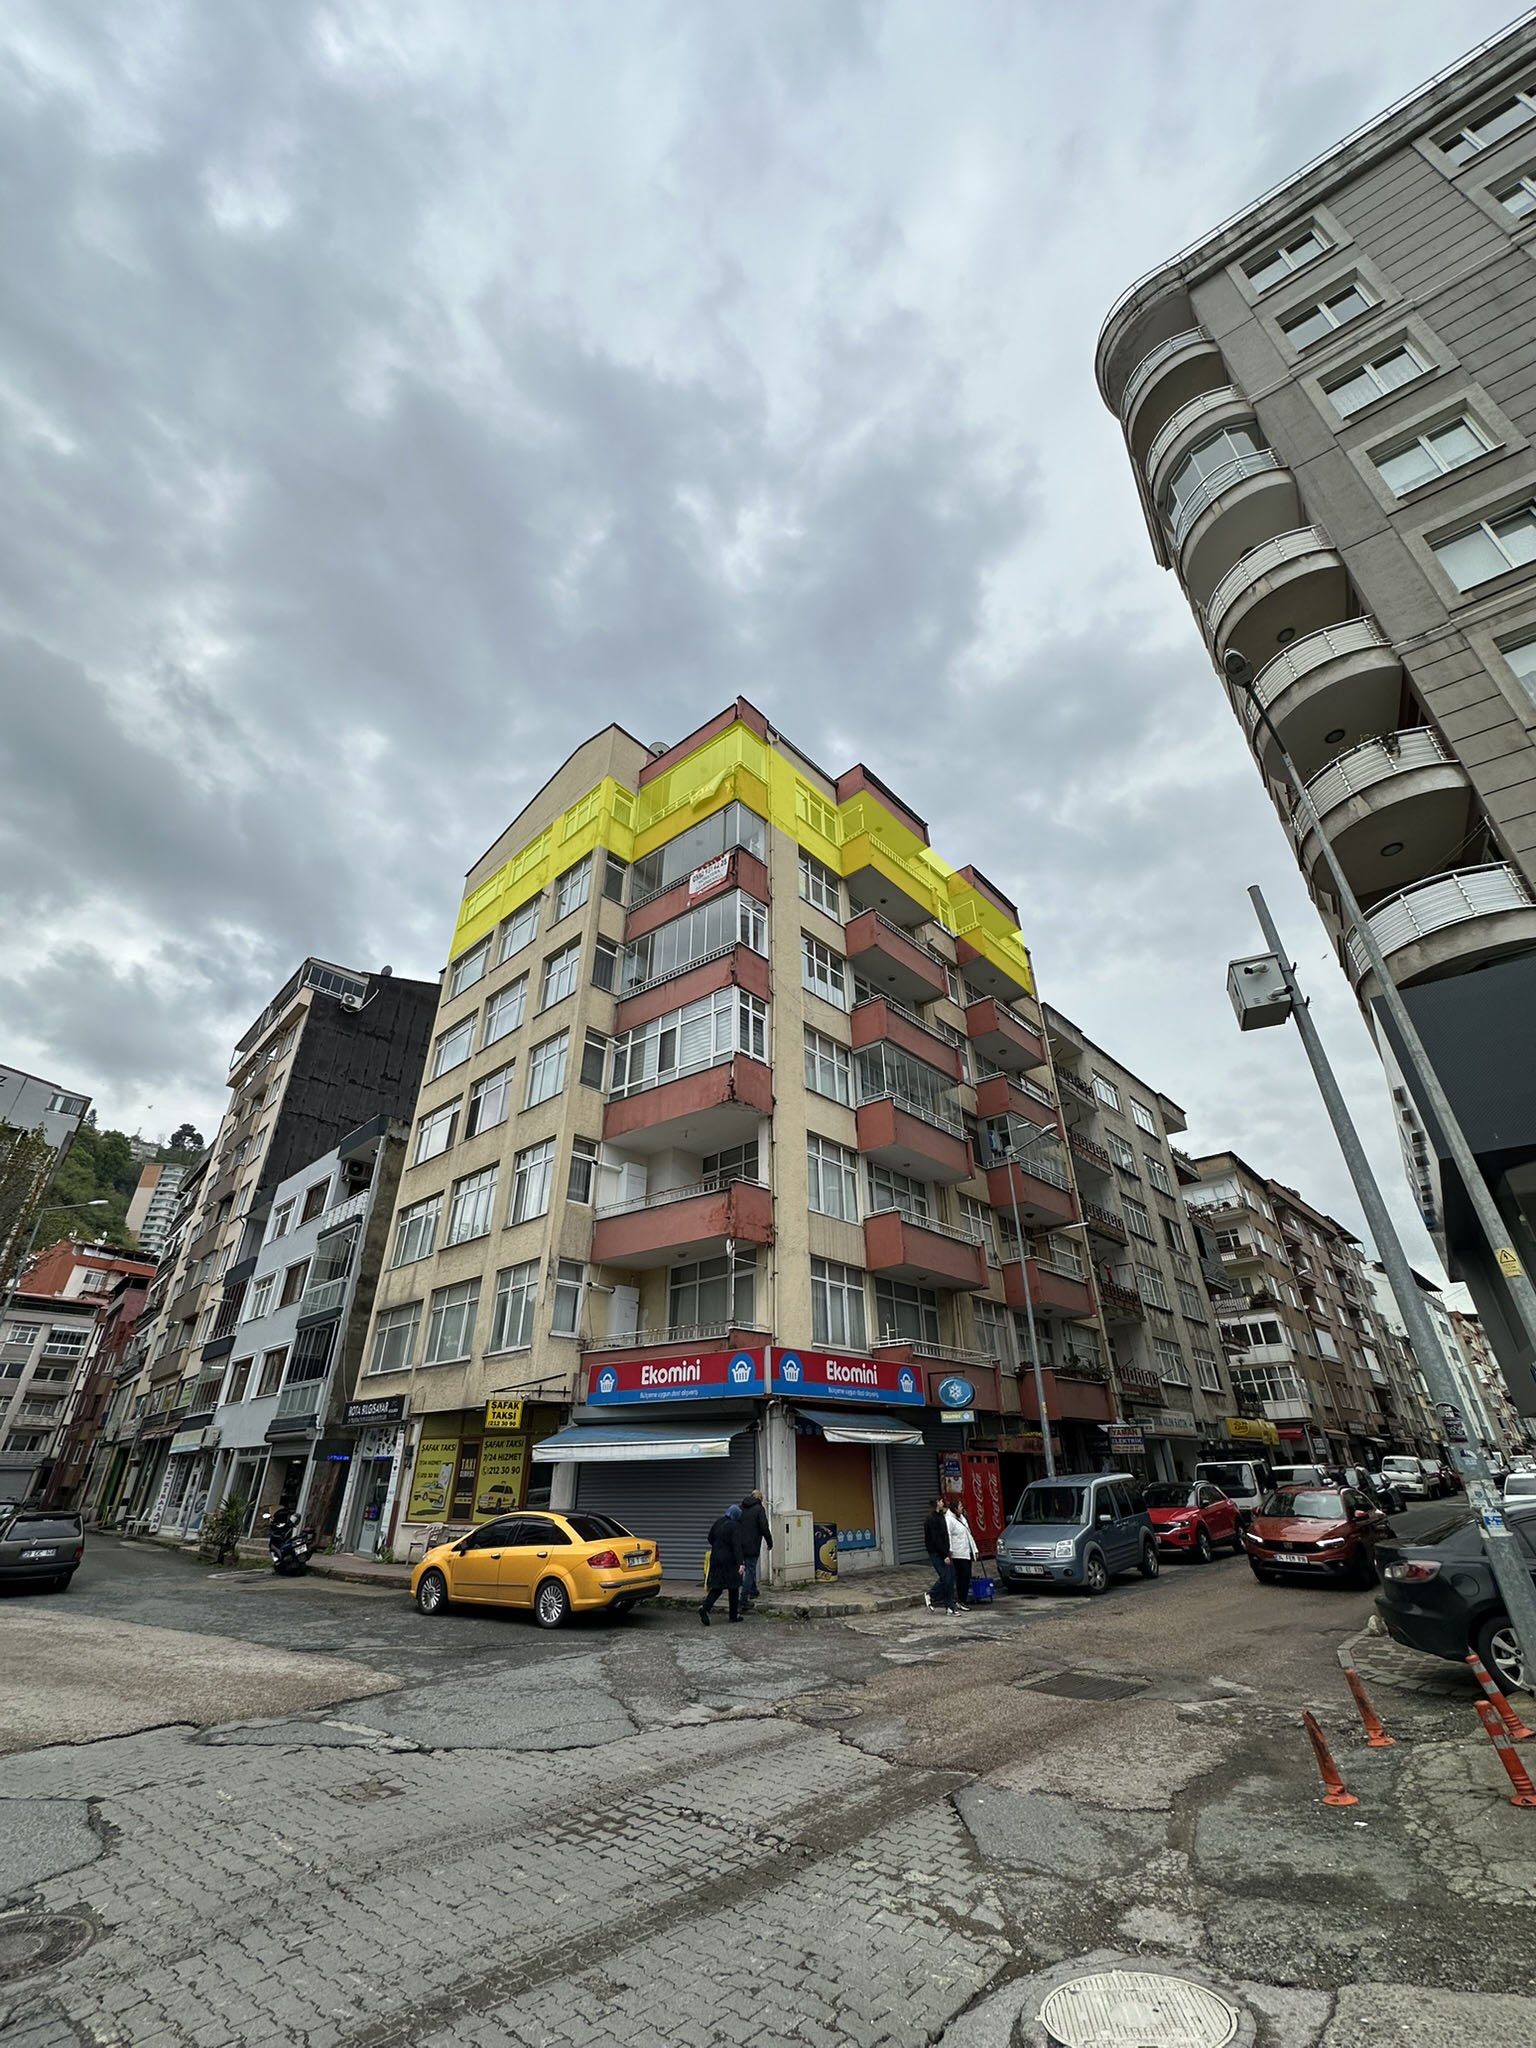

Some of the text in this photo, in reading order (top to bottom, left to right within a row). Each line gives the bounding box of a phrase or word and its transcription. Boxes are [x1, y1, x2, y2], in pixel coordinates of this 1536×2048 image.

[641, 1359, 701, 1386] Ekomini
[825, 1359, 878, 1385] Ekomini
[1112, 1428, 1138, 1436] YAMAN
[483, 1453, 498, 1462] 7/24
[489, 1465, 521, 1475] 212 30 90
